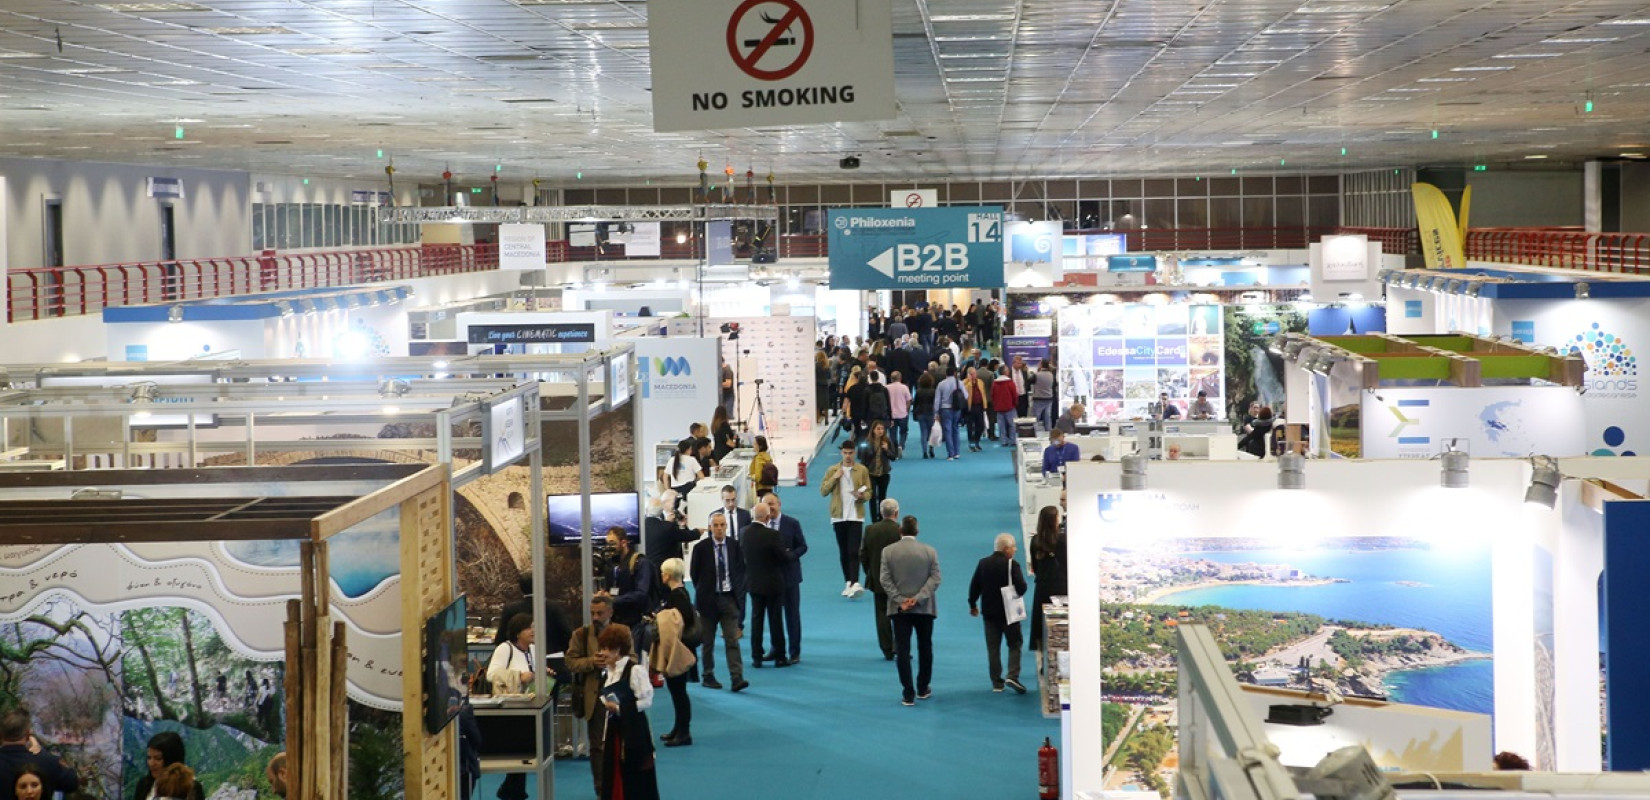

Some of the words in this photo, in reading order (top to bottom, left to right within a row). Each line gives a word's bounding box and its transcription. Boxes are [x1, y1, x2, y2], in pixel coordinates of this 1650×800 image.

[692, 92, 728, 111] NO
[741, 85, 855, 109] SMOKING
[850, 216, 916, 228] Philoxenia
[970, 221, 1001, 242] 14
[504, 243, 533, 251] CENTRAL
[897, 243, 969, 272] B2B
[897, 273, 940, 285] meeting
[942, 273, 969, 285] point
[516, 328, 557, 339] CINEMATIC
